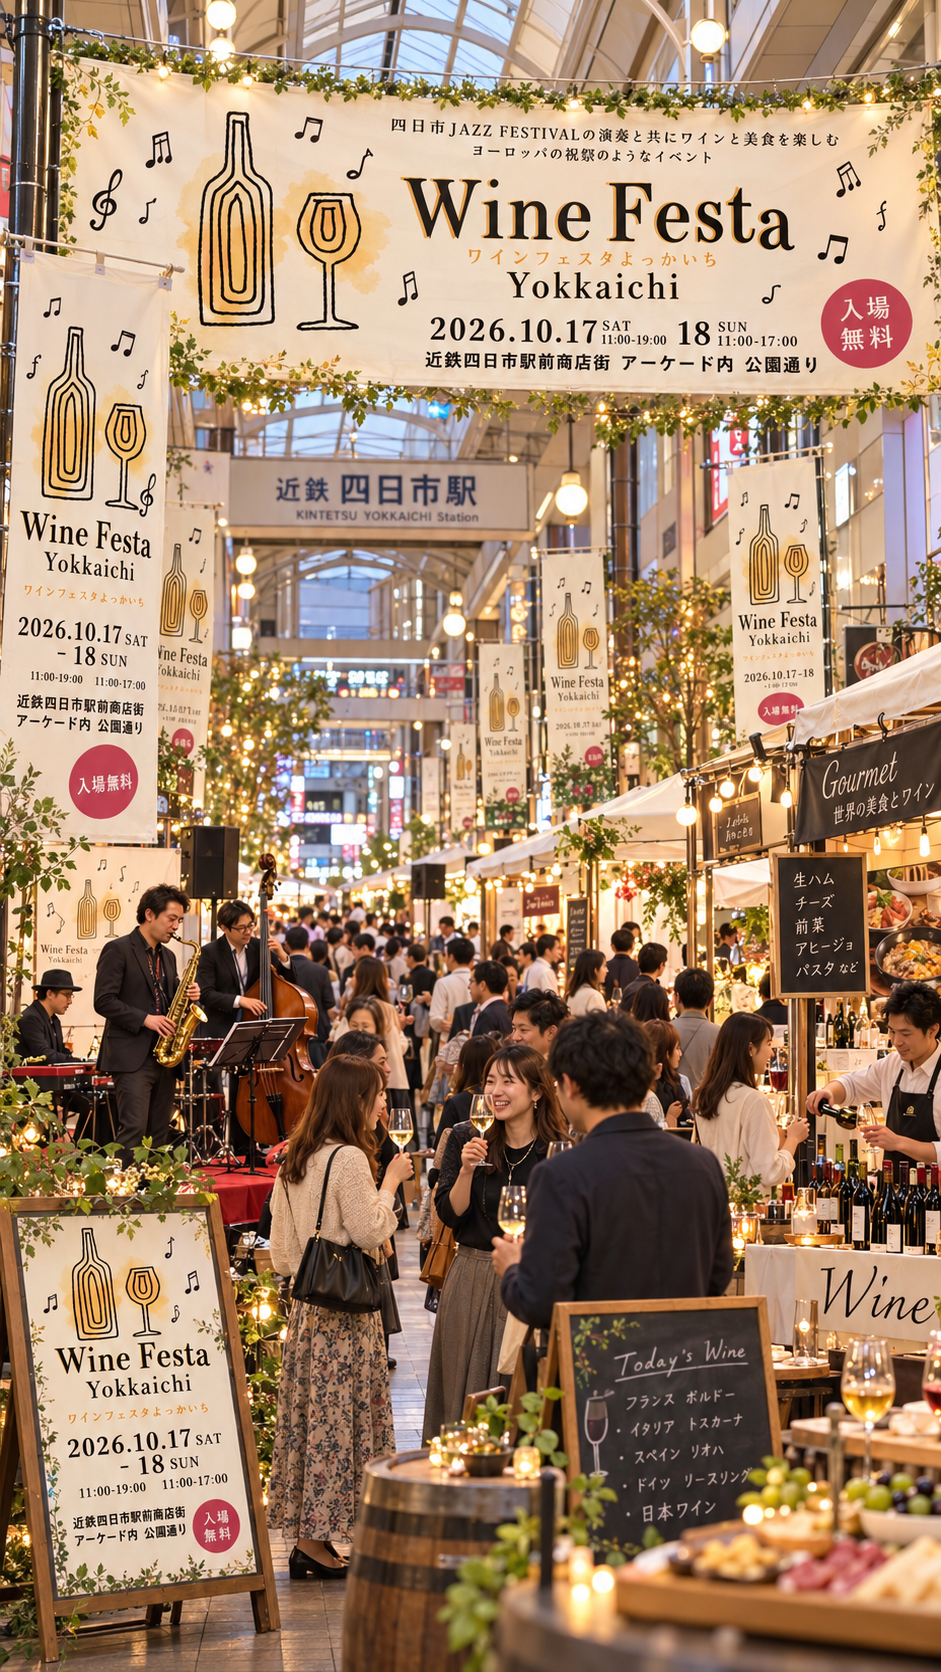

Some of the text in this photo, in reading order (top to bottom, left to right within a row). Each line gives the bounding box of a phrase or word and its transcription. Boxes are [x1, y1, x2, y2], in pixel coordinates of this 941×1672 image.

[391, 118, 493, 138] 四日市JAZZ
[400, 176, 796, 251] Wine Festa
[468, 248, 717, 268] ワインフェスタよっかいち
[506, 271, 679, 300] Yokkaichi
[840, 295, 890, 322] 入場
[430, 316, 711, 346] 2026.10.17 18
[602, 320, 747, 333] SAT SUN
[602, 334, 798, 347] 11:00-19:00 11:00-17:00
[840, 324, 894, 352] 無料
[425, 351, 817, 374] 近鉄四日市駅前商店街 アーケード内 公園通り
[276, 474, 477, 507] 近鉄 四日市駅
[296, 510, 479, 523] KINTETSU YOKKAICHI Station
[19, 510, 152, 559] Wine Festa
[44, 551, 135, 582] Yokkaichi
[24, 584, 144, 608] ワインフェスタよっかいち
[17, 616, 149, 648] 2026.10.17 SAT
[738, 611, 818, 631] Wine Festa
[748, 631, 810, 647] Yokkaichi
[74, 645, 96, 667] 18
[100, 652, 128, 668] SUN
[180, 647, 208, 668] Festa
[31, 670, 83, 684] 11:00-19:00
[95, 676, 146, 691] 11:00-17:00
[550, 675, 604, 689] Wine Festa
[557, 690, 600, 702] Yokkaichi
[16, 714, 91, 732] アーケード内
[77, 772, 132, 794] 入場無料
[821, 751, 899, 800] Gourmet
[833, 782, 935, 826] 世界の美食とワイン
[793, 871, 835, 889] 生ハム
[795, 893, 835, 912] チーズ
[795, 916, 825, 935] 前菜
[40, 944, 64, 954] Wine
[65, 944, 88, 955] Festa
[795, 936, 853, 957] アヒージョ
[795, 961, 859, 977] パスタ など
[820, 1265, 938, 1325] Wine
[54, 1341, 211, 1375] Wine Festa
[613, 1338, 746, 1379] Today's Wine
[85, 1373, 192, 1399] Yokkaichi
[626, 1389, 735, 1411] フランス ボルドー
[68, 1402, 209, 1425] ワインフェスタよっかいち
[630, 1413, 743, 1438] イタリア トスカーナ
[67, 1429, 222, 1459] 2026.10.17 SAT
[634, 1443, 724, 1464] スペイン リオハ
[138, 1454, 165, 1475] 18
[169, 1455, 199, 1470] SUN
[79, 1473, 228, 1499] 11:00-19:00 11:00-17:00
[638, 1466, 754, 1493] ドイツ リースリング
[203, 1509, 229, 1526] 入場
[642, 1499, 719, 1525] 日本ワイン
[73, 1527, 138, 1547] アーケード内
[203, 1526, 231, 1543] 無料
